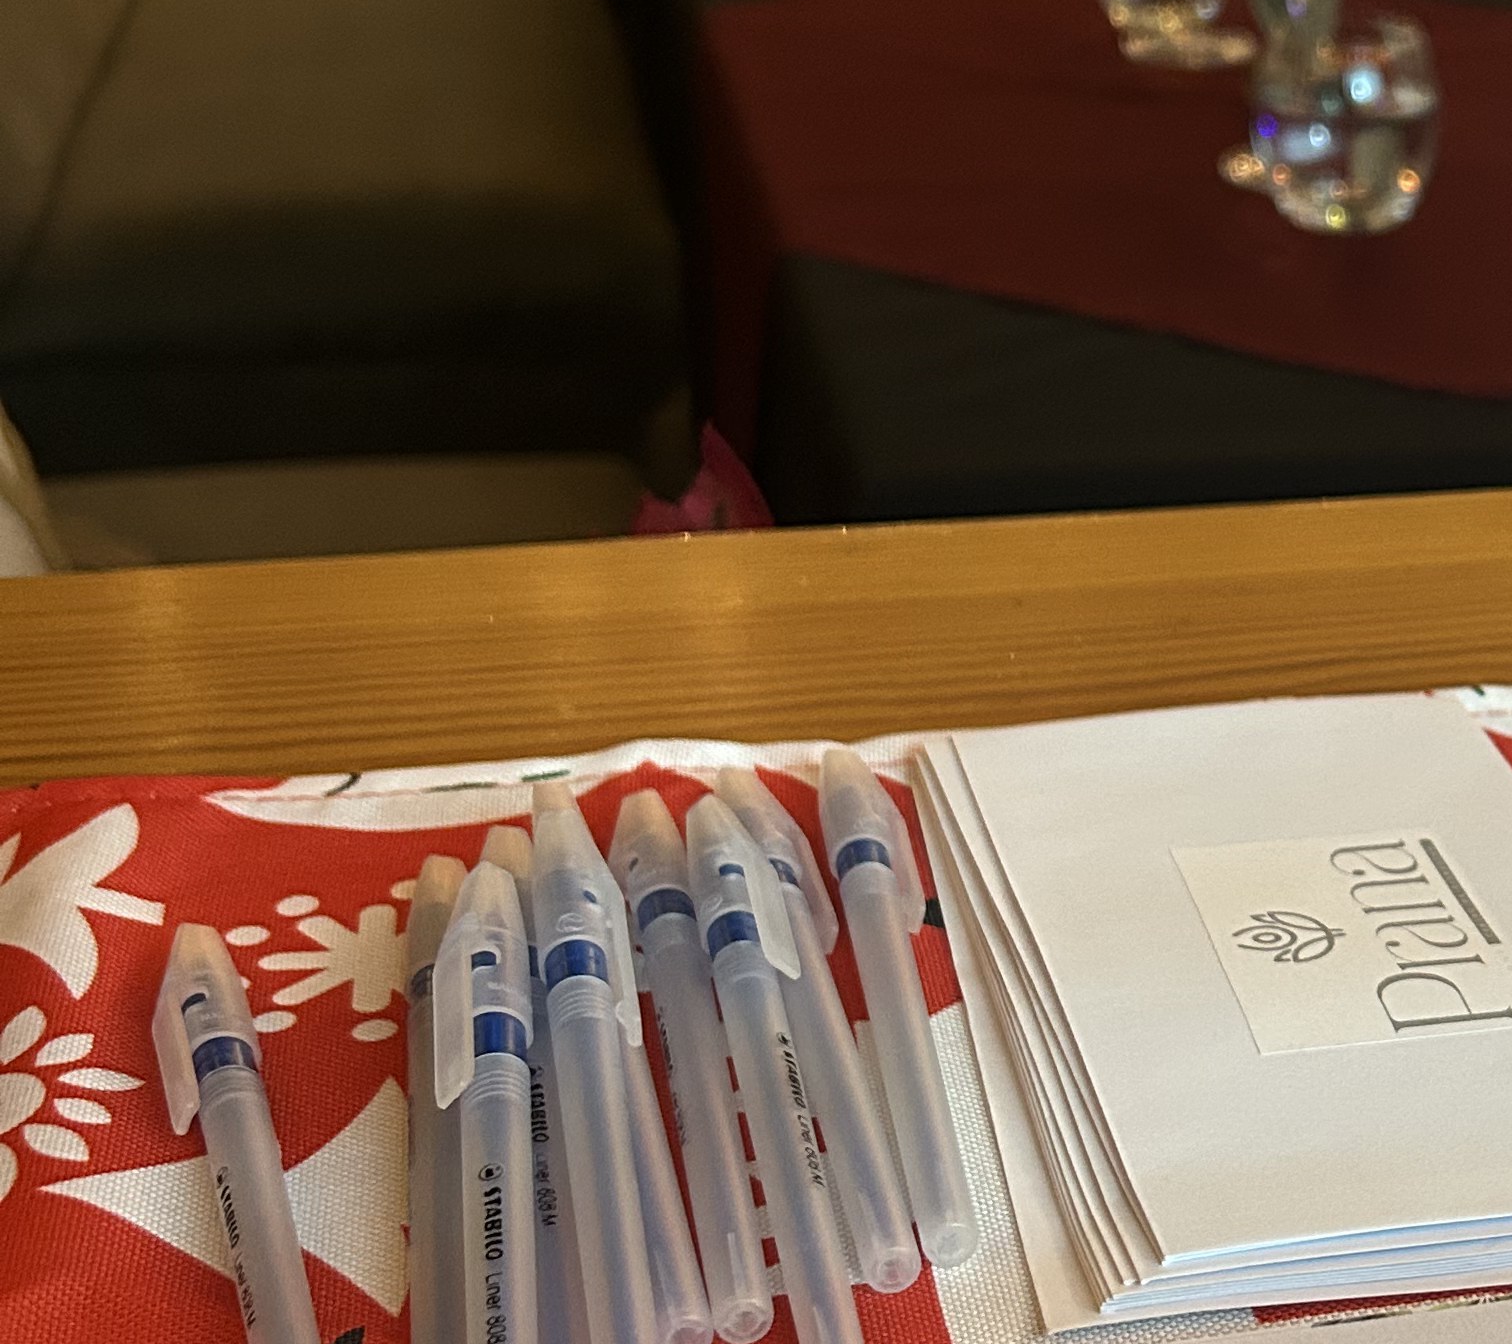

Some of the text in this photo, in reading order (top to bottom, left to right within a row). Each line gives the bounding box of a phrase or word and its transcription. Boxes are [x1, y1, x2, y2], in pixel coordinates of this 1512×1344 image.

[483, 1185, 504, 1262] STABILO
[485, 1272, 504, 1310] Liner
[486, 1314, 507, 1344] 808
